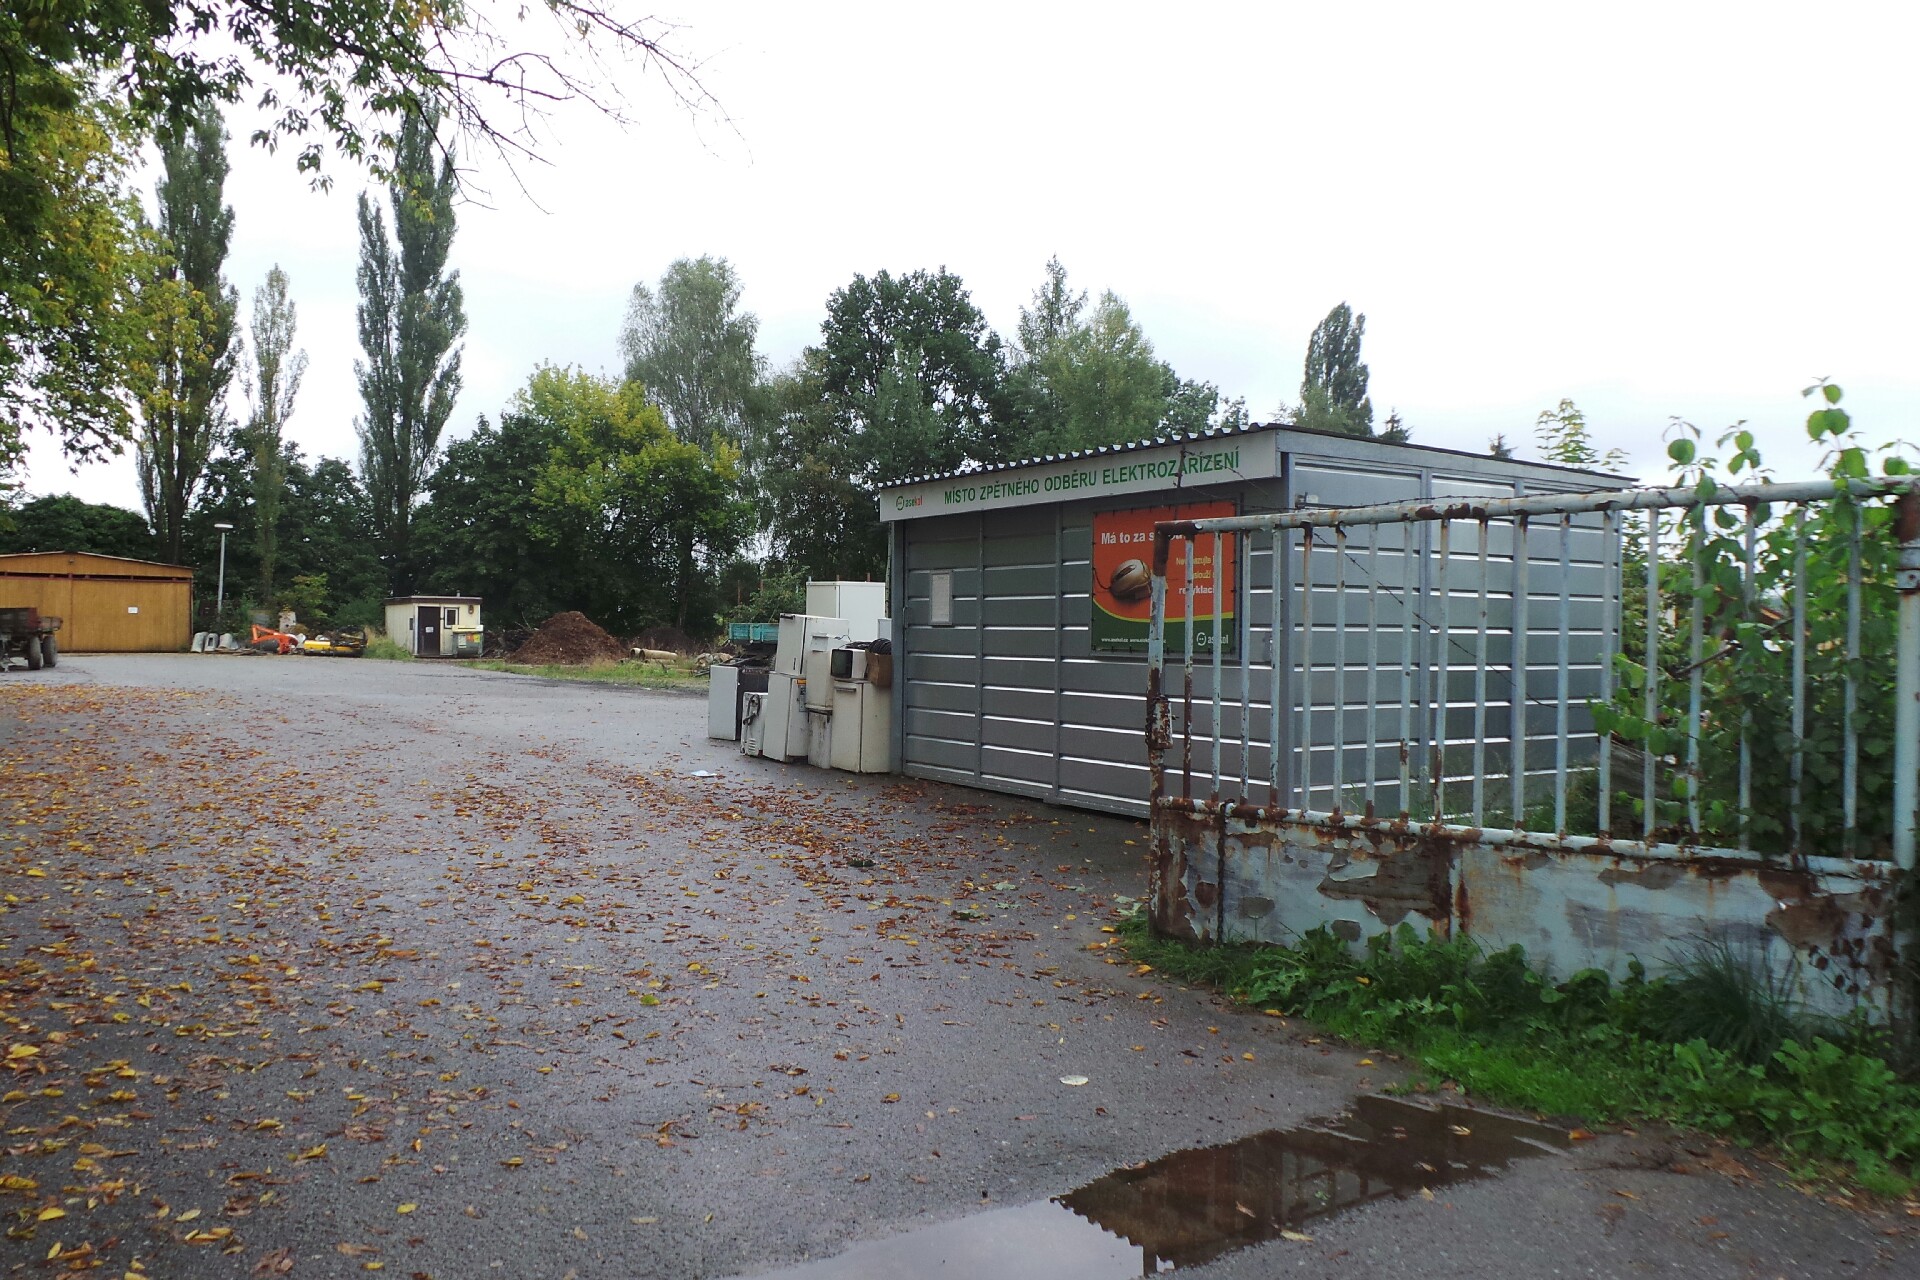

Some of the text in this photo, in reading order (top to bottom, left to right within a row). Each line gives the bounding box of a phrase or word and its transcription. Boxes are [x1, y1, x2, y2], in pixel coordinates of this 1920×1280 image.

[944, 486, 976, 505] MÍSTO
[980, 478, 1039, 500] ZPĚTNÉHO
[1044, 468, 1097, 492] ODBĚRU
[1101, 532, 1116, 545] Má
[1119, 532, 1131, 543] to
[1133, 532, 1145, 542] za
